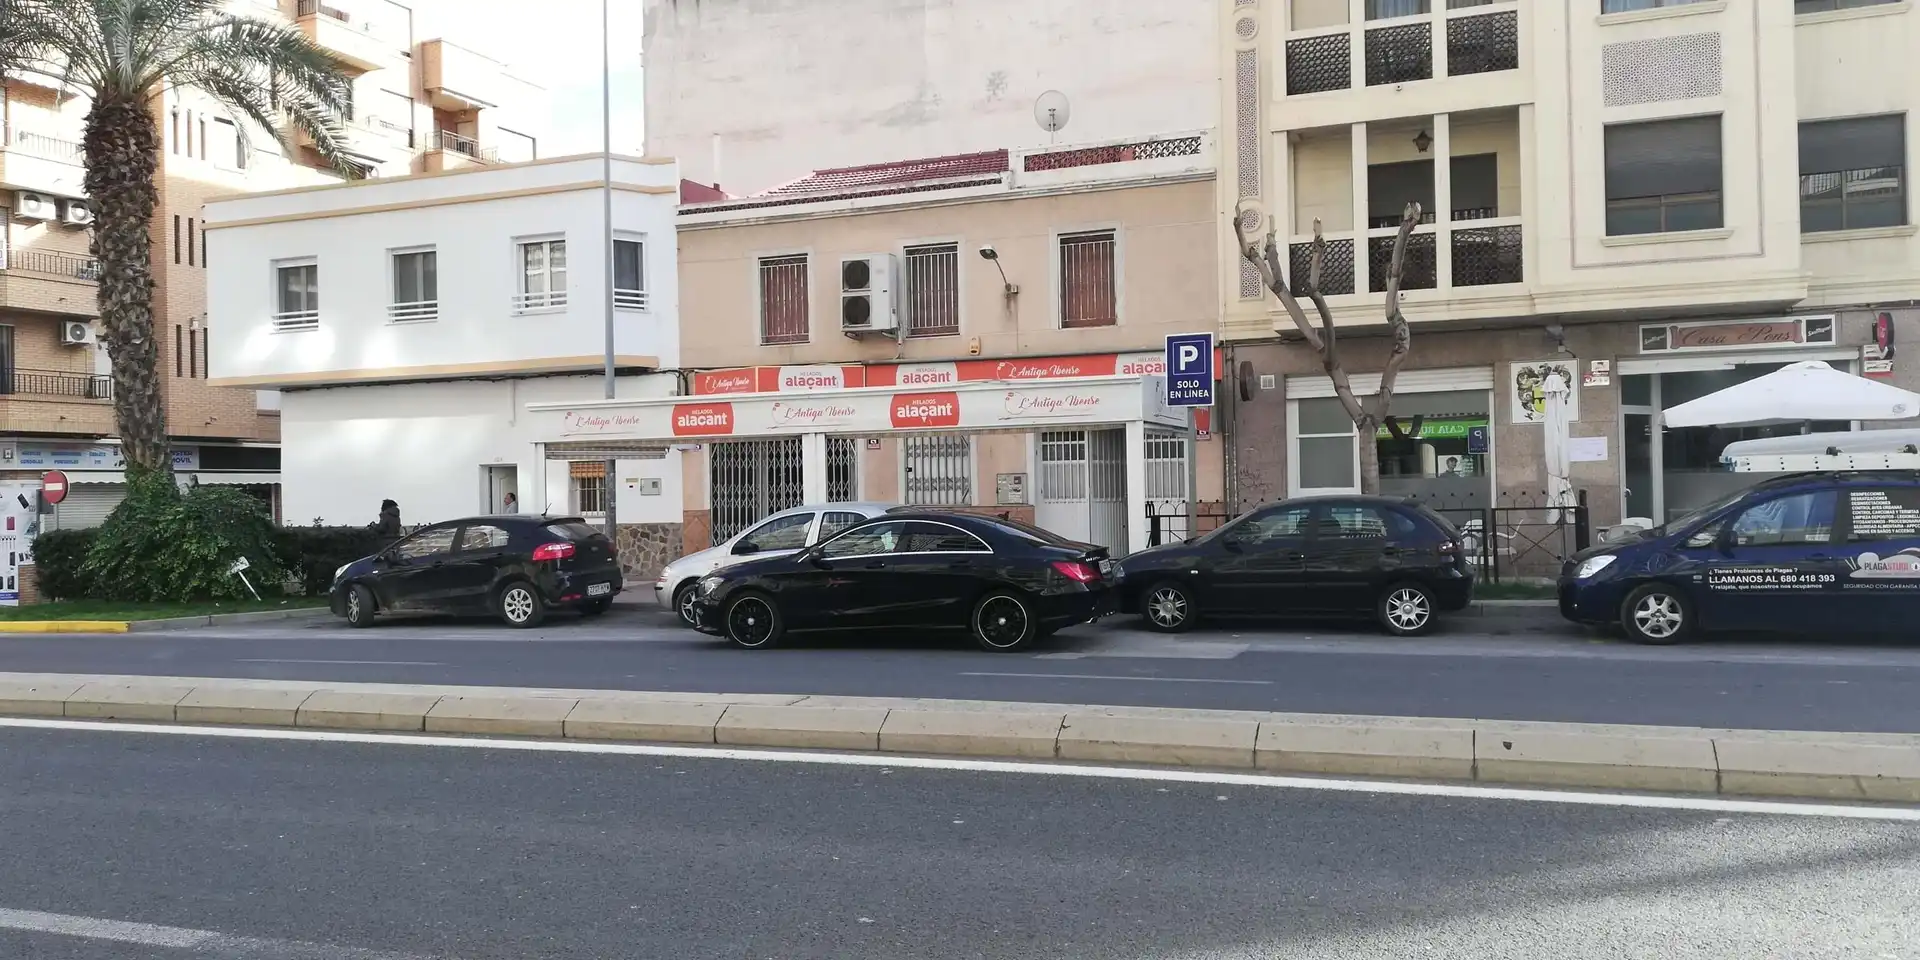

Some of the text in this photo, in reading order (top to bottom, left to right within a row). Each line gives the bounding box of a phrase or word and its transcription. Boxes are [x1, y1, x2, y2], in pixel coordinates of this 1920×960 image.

[1682, 324, 1791, 345] Casa Pons
[1180, 345, 1199, 371] P
[1123, 362, 1166, 375] alaca
[1177, 380, 1199, 389] SOLO
[1170, 388, 1209, 399] EN LÍNEA
[1709, 575, 1763, 583] LLAMANOS
[1780, 575, 1797, 583] 680
[1799, 574, 1816, 582] 418
[1818, 574, 1835, 582] 393
